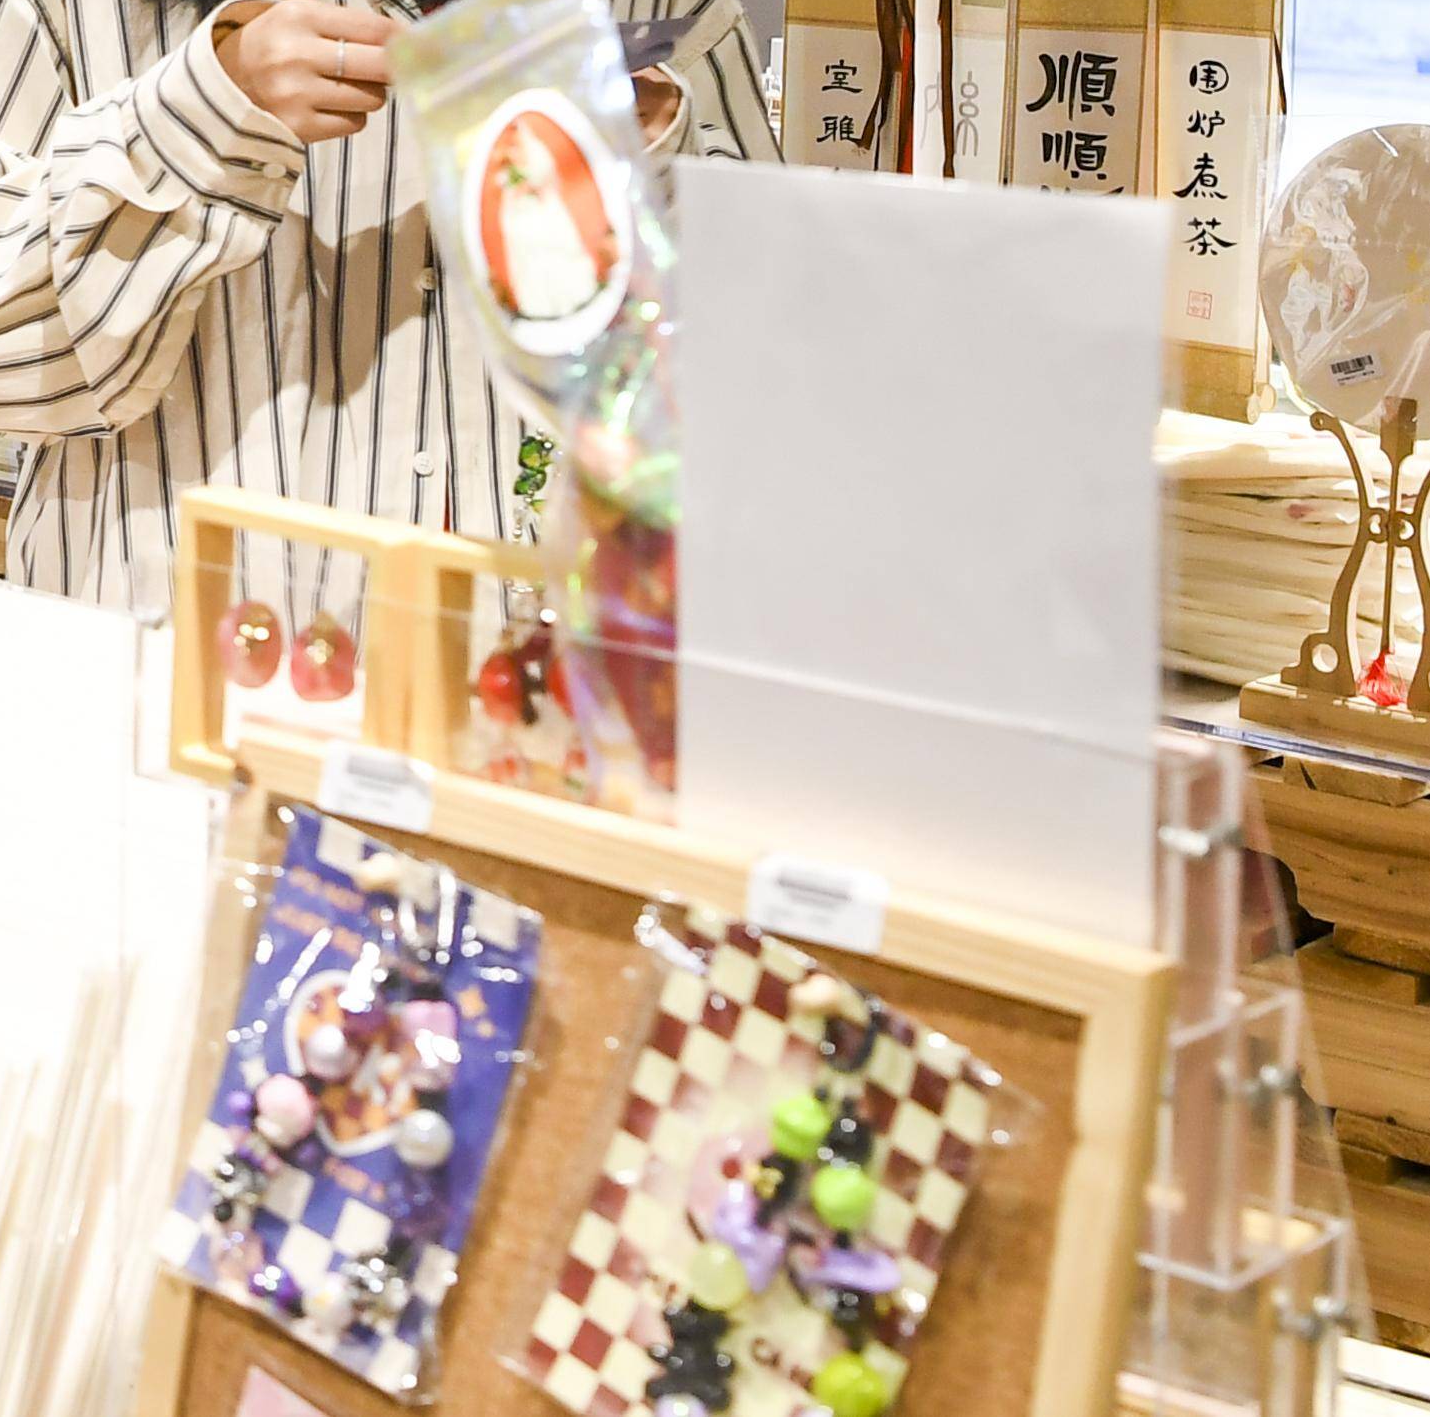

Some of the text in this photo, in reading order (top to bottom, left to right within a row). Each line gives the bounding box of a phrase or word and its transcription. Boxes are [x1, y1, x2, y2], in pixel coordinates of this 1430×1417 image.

[1026, 49, 1126, 196] 順順
[1172, 59, 1238, 256] 围炉煮茶
